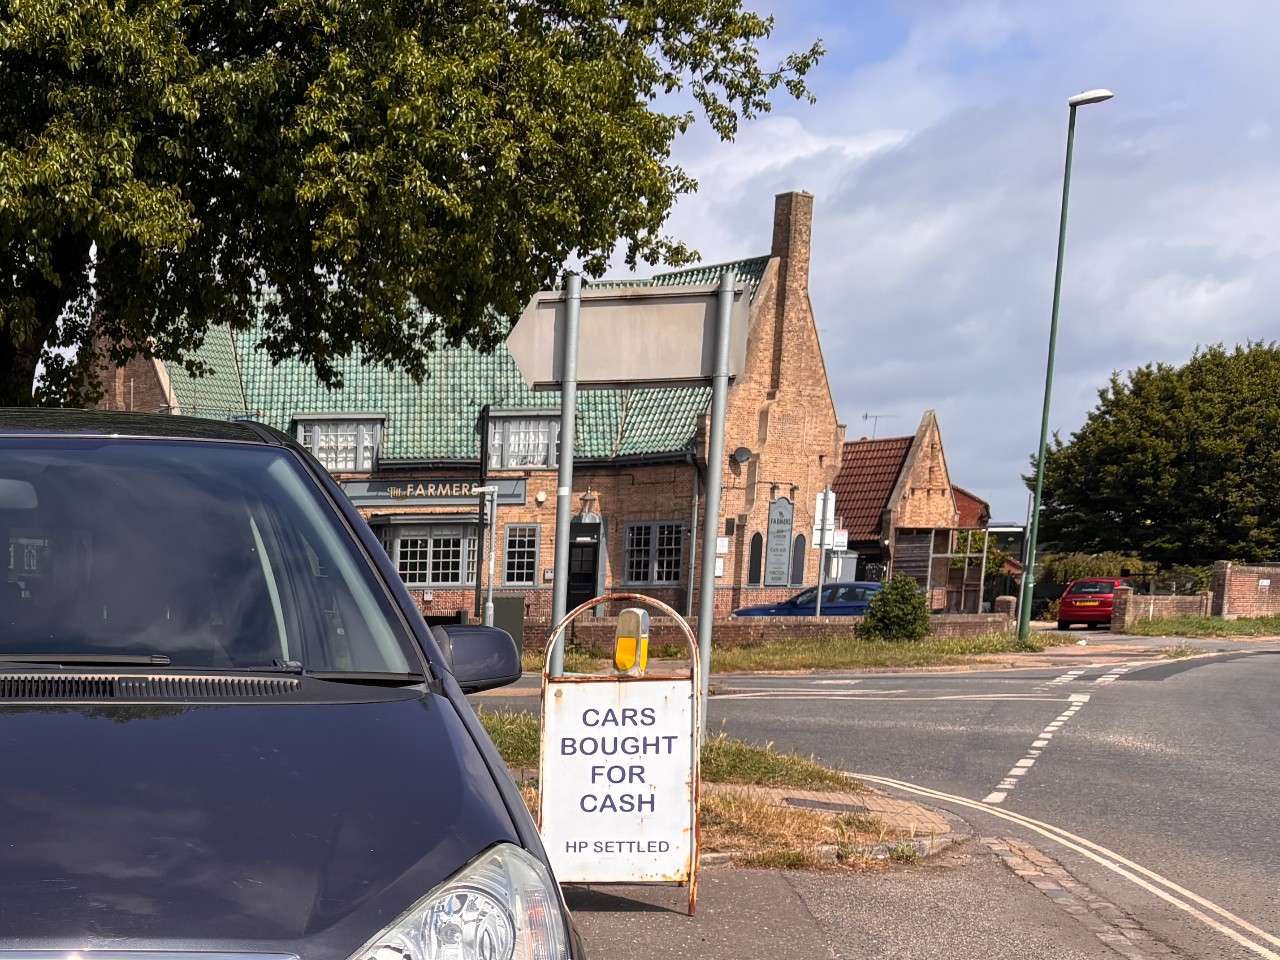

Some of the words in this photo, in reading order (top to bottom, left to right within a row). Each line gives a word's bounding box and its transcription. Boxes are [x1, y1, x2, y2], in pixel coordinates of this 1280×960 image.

[406, 483, 479, 497] FARMERS
[582, 707, 656, 727] CARS
[560, 735, 679, 756] BOUGHT
[591, 765, 646, 785] FOR
[579, 793, 656, 813] CASH
[565, 840, 589, 853] HP
[593, 840, 671, 853] SETTLED
